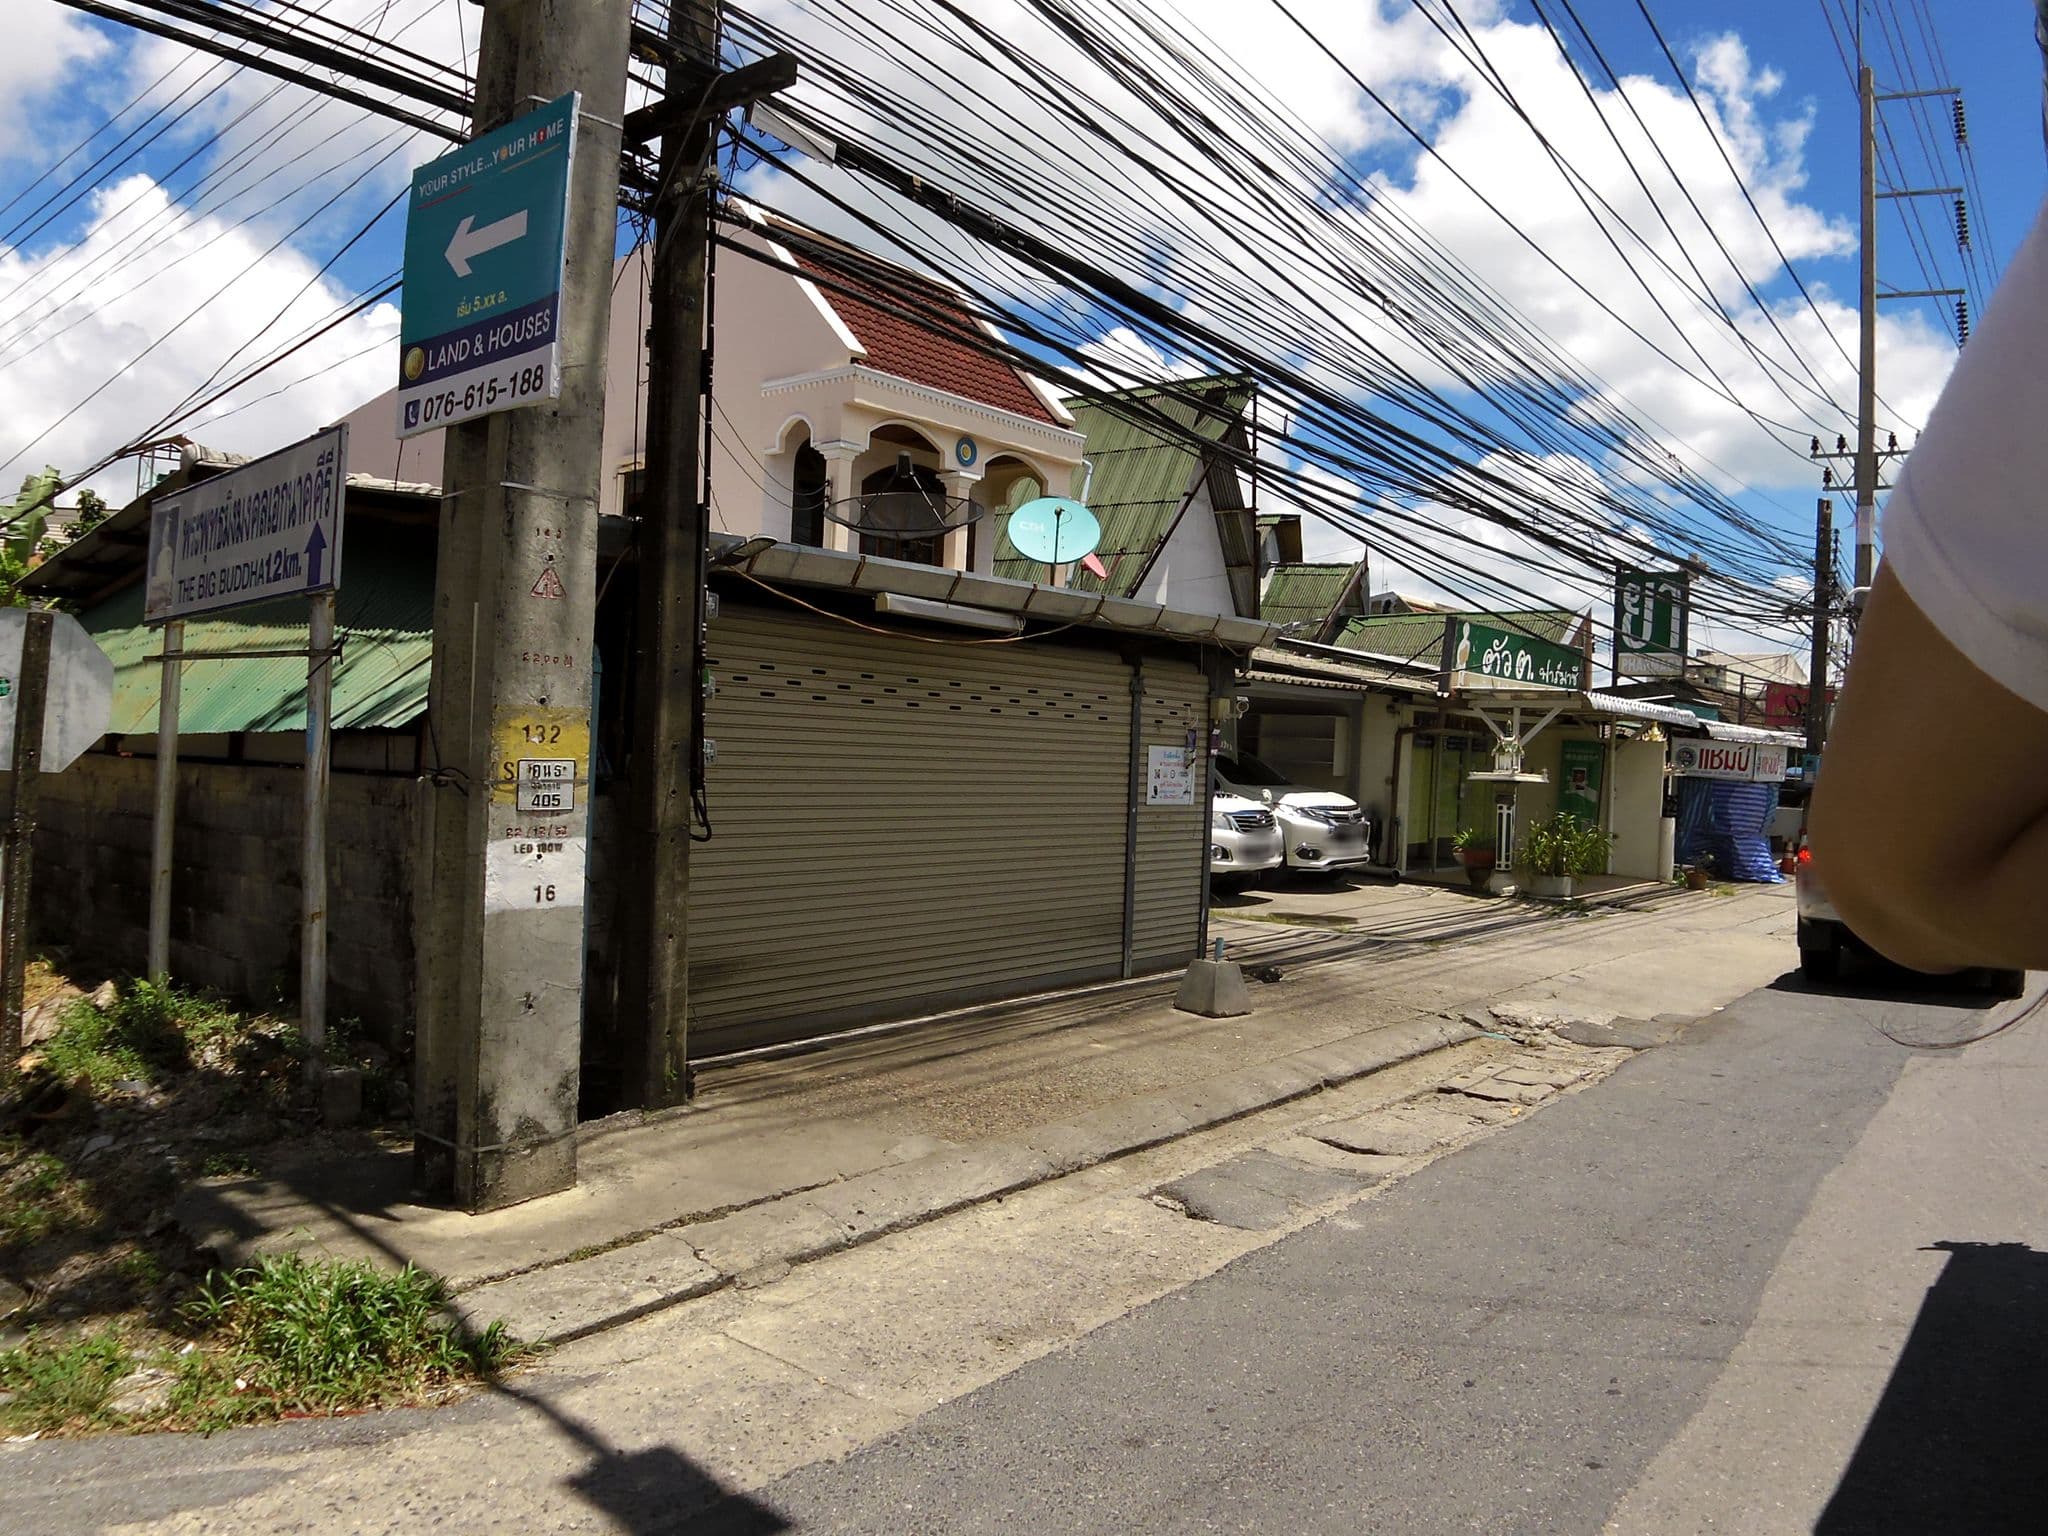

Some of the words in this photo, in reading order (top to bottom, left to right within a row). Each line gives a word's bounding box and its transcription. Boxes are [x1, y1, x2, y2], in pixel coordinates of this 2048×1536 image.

[419, 174, 448, 198] YOUR
[529, 118, 564, 147] HOME
[428, 338, 470, 371] LAND
[473, 333, 484, 356] &
[488, 309, 551, 352] HOUSES
[423, 364, 544, 423] 076-615-188
[178, 573, 195, 604] THE
[198, 568, 216, 599] BIG
[219, 558, 265, 595] BUDDHA
[1621, 581, 1681, 649] ยา
[1482, 636, 1512, 677] ตัว
[523, 724, 561, 744] 132
[531, 794, 561, 807] 405
[513, 843, 533, 854] LED
[534, 885, 555, 903] 16
